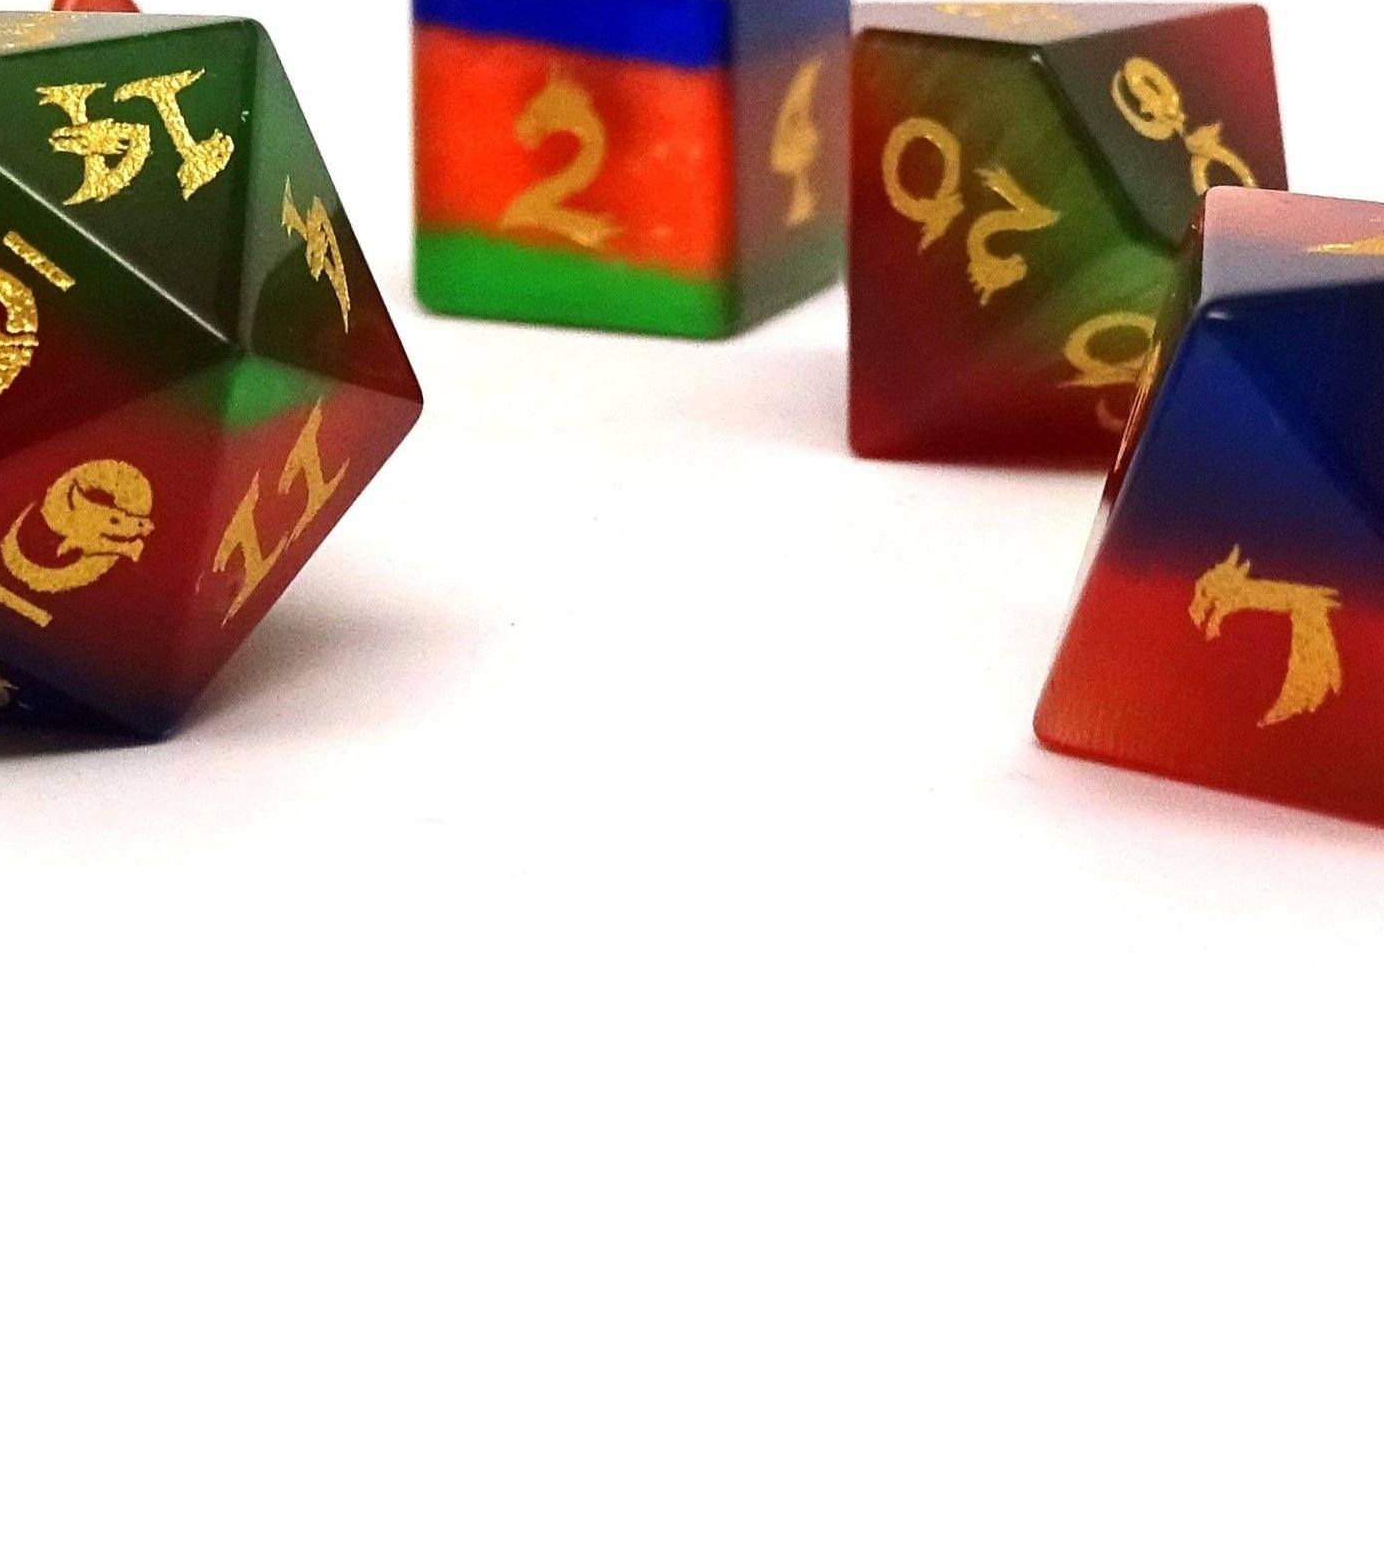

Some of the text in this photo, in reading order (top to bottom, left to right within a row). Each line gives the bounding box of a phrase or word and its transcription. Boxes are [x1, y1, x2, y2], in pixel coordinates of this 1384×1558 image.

[35, 68, 236, 206] 14
[500, 62, 625, 248] 2
[770, 55, 820, 226] 4
[881, 116, 1063, 306] 20
[212, 396, 351, 627] 11
[1187, 543, 1342, 728] 7
